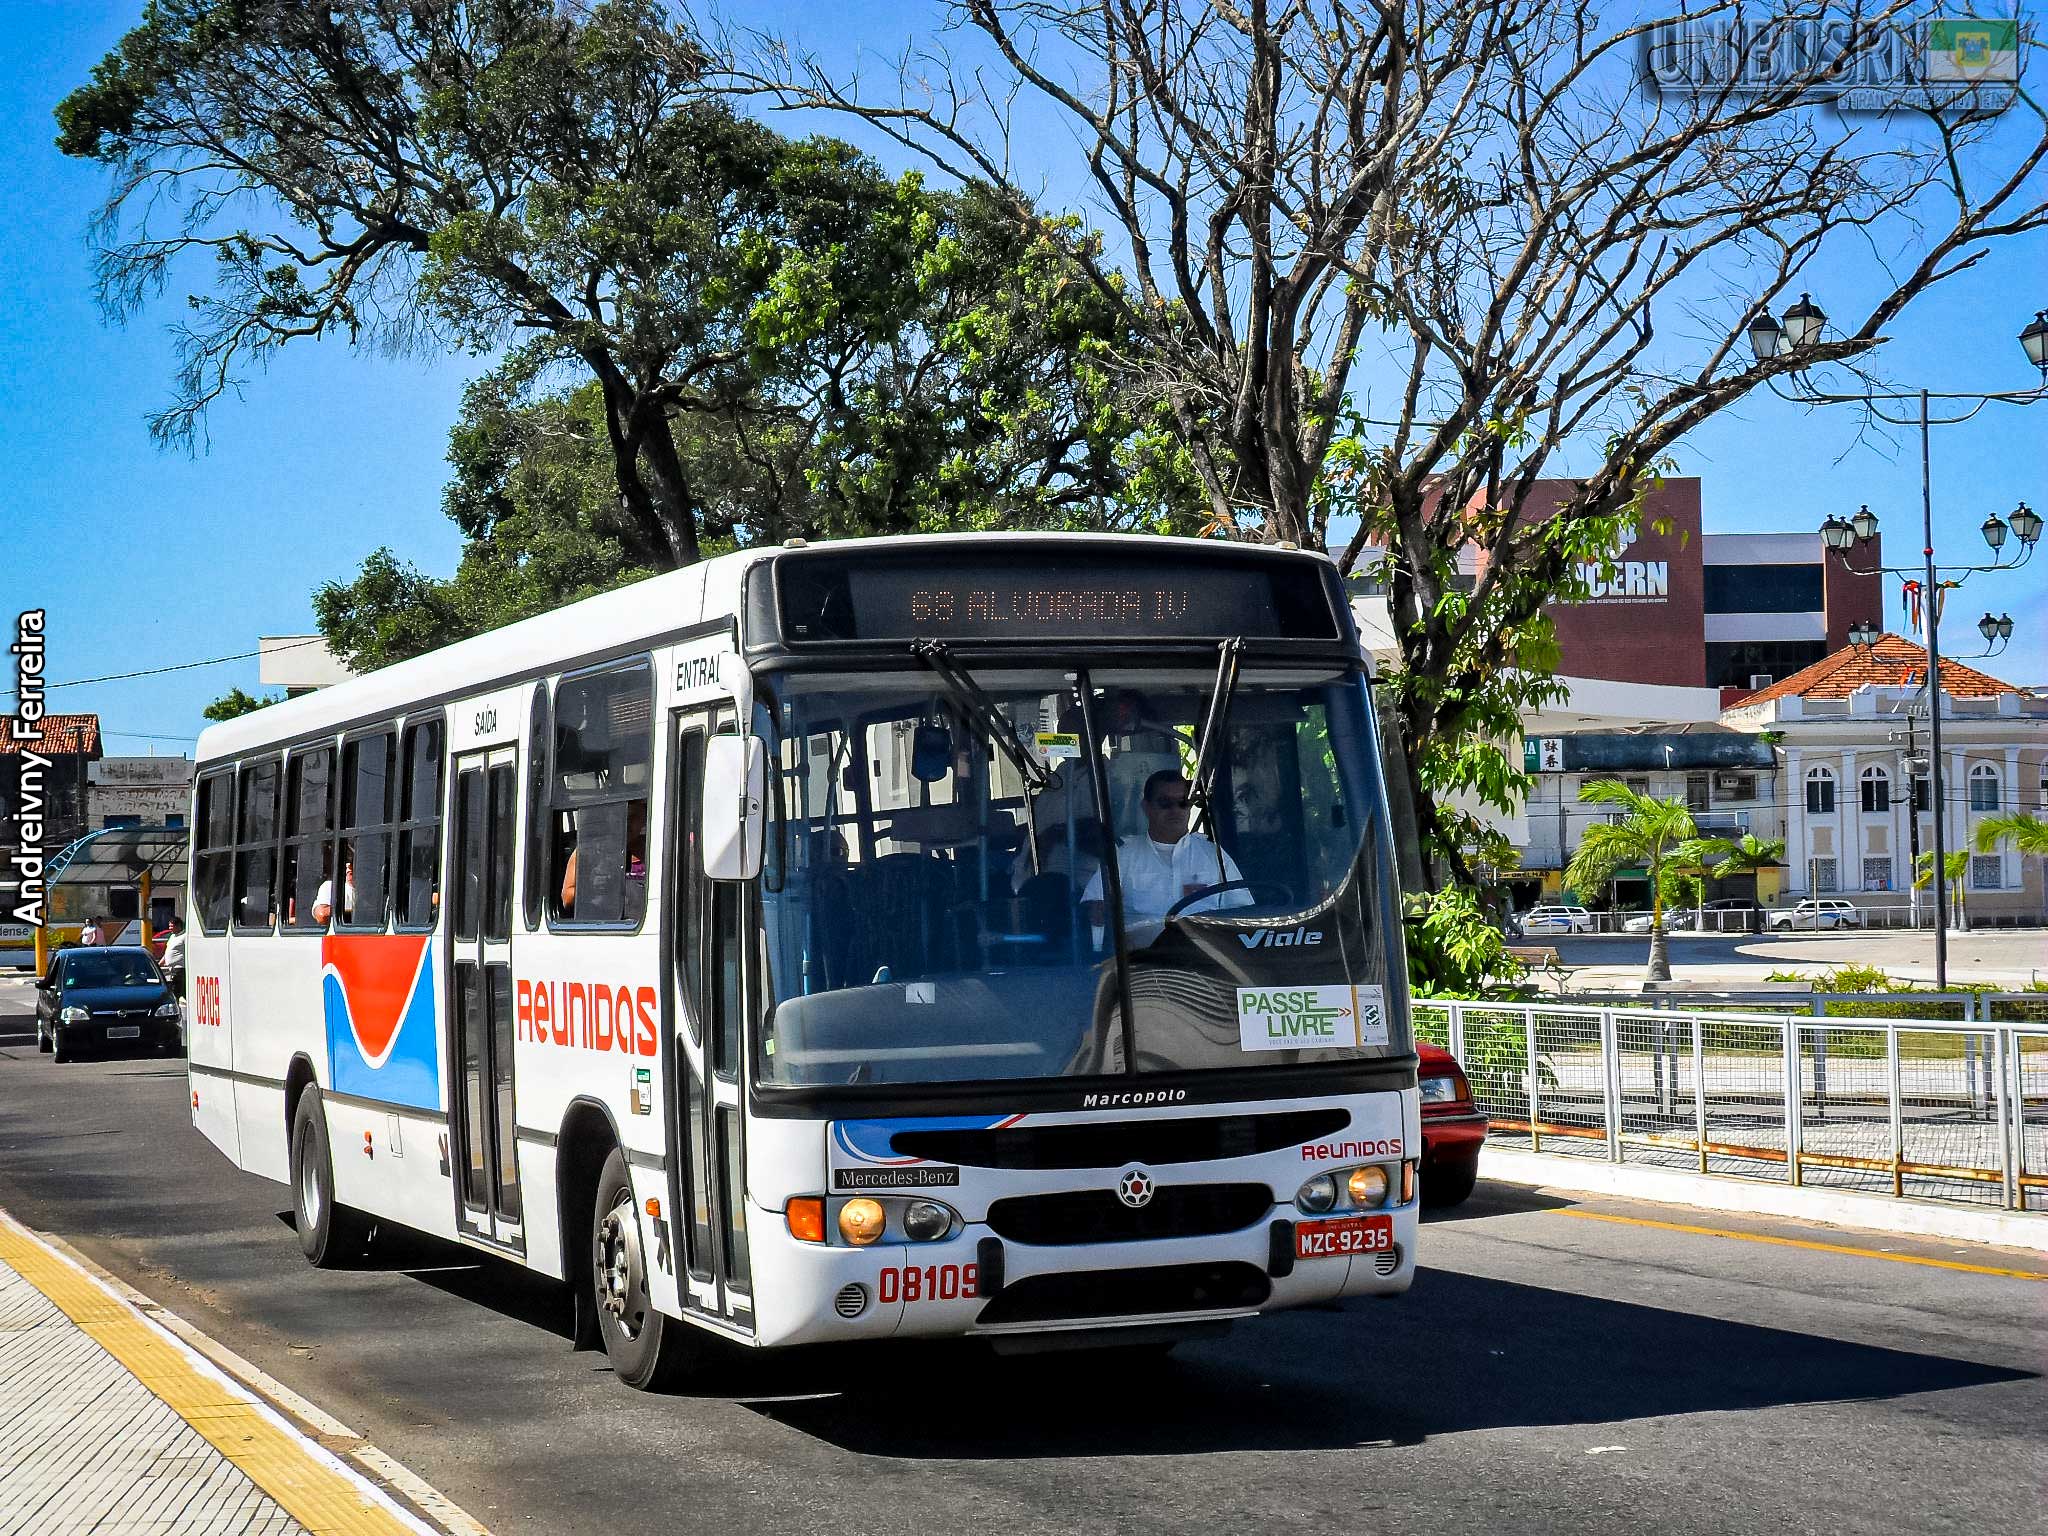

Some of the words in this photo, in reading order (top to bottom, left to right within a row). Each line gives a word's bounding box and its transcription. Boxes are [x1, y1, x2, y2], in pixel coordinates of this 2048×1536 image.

[911, 591, 954, 620] 68
[968, 591, 1141, 620] ALVORADA
[1153, 591, 1188, 620] IV
[677, 653, 720, 692] ENTRA
[475, 704, 497, 737] SAÍDA
[1237, 926, 1323, 949] Viale
[196, 975, 220, 1027] 08109
[1241, 991, 1339, 1015] PASSE
[1266, 1013, 1338, 1038] LIVRE
[1083, 1088, 1186, 1108] Marcopolo
[841, 1169, 954, 1187] Mercedes-Benz
[879, 1263, 978, 1304] 08109
